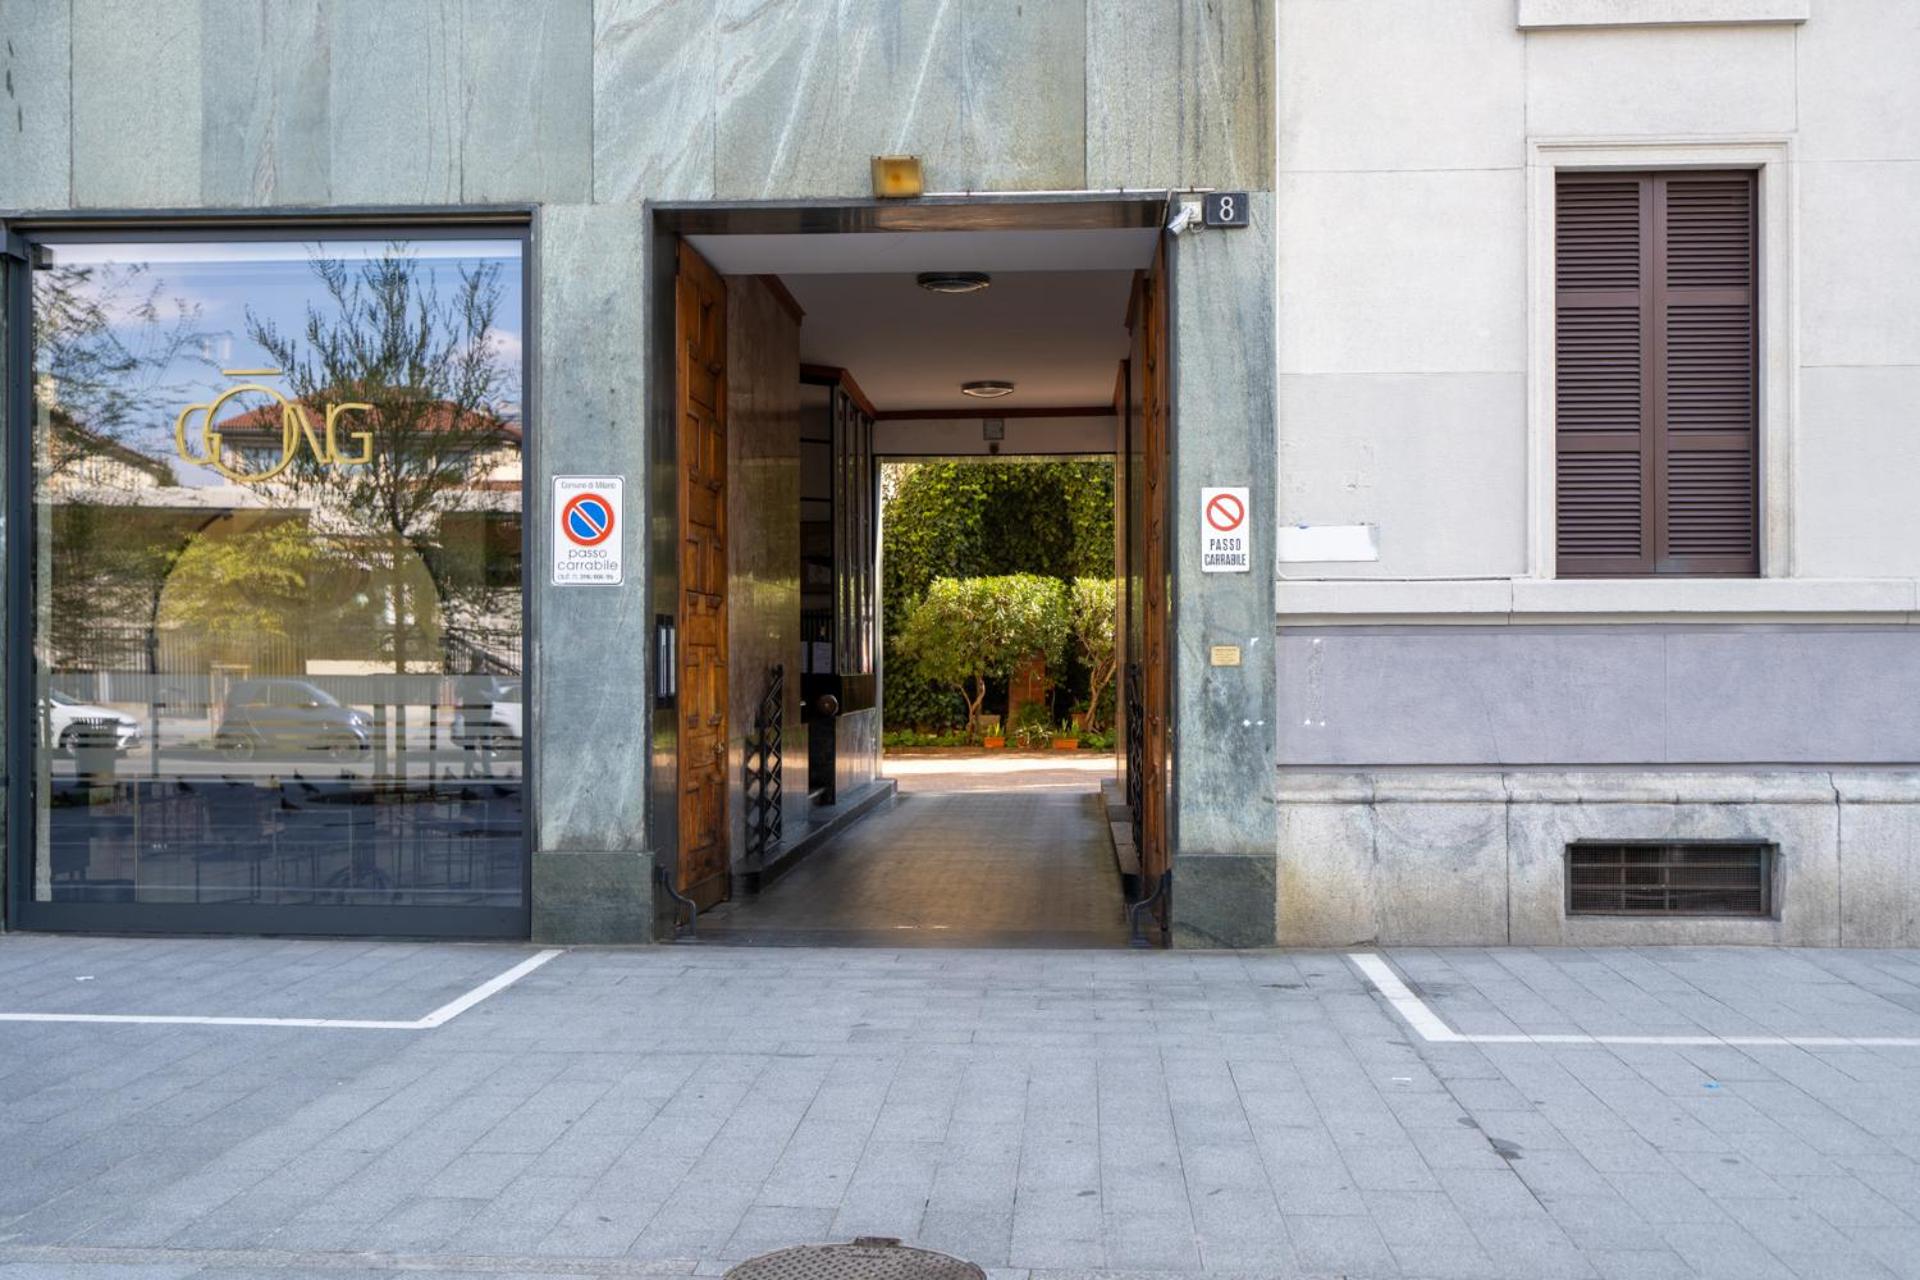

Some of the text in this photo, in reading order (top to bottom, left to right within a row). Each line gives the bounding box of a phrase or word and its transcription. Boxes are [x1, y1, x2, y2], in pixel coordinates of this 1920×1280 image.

[1219, 196, 1234, 221] 8
[1210, 538, 1241, 551] PASSO
[568, 549, 608, 560] passo
[1204, 553, 1246, 566] CARRABILE
[557, 559, 618, 571] carrabile
